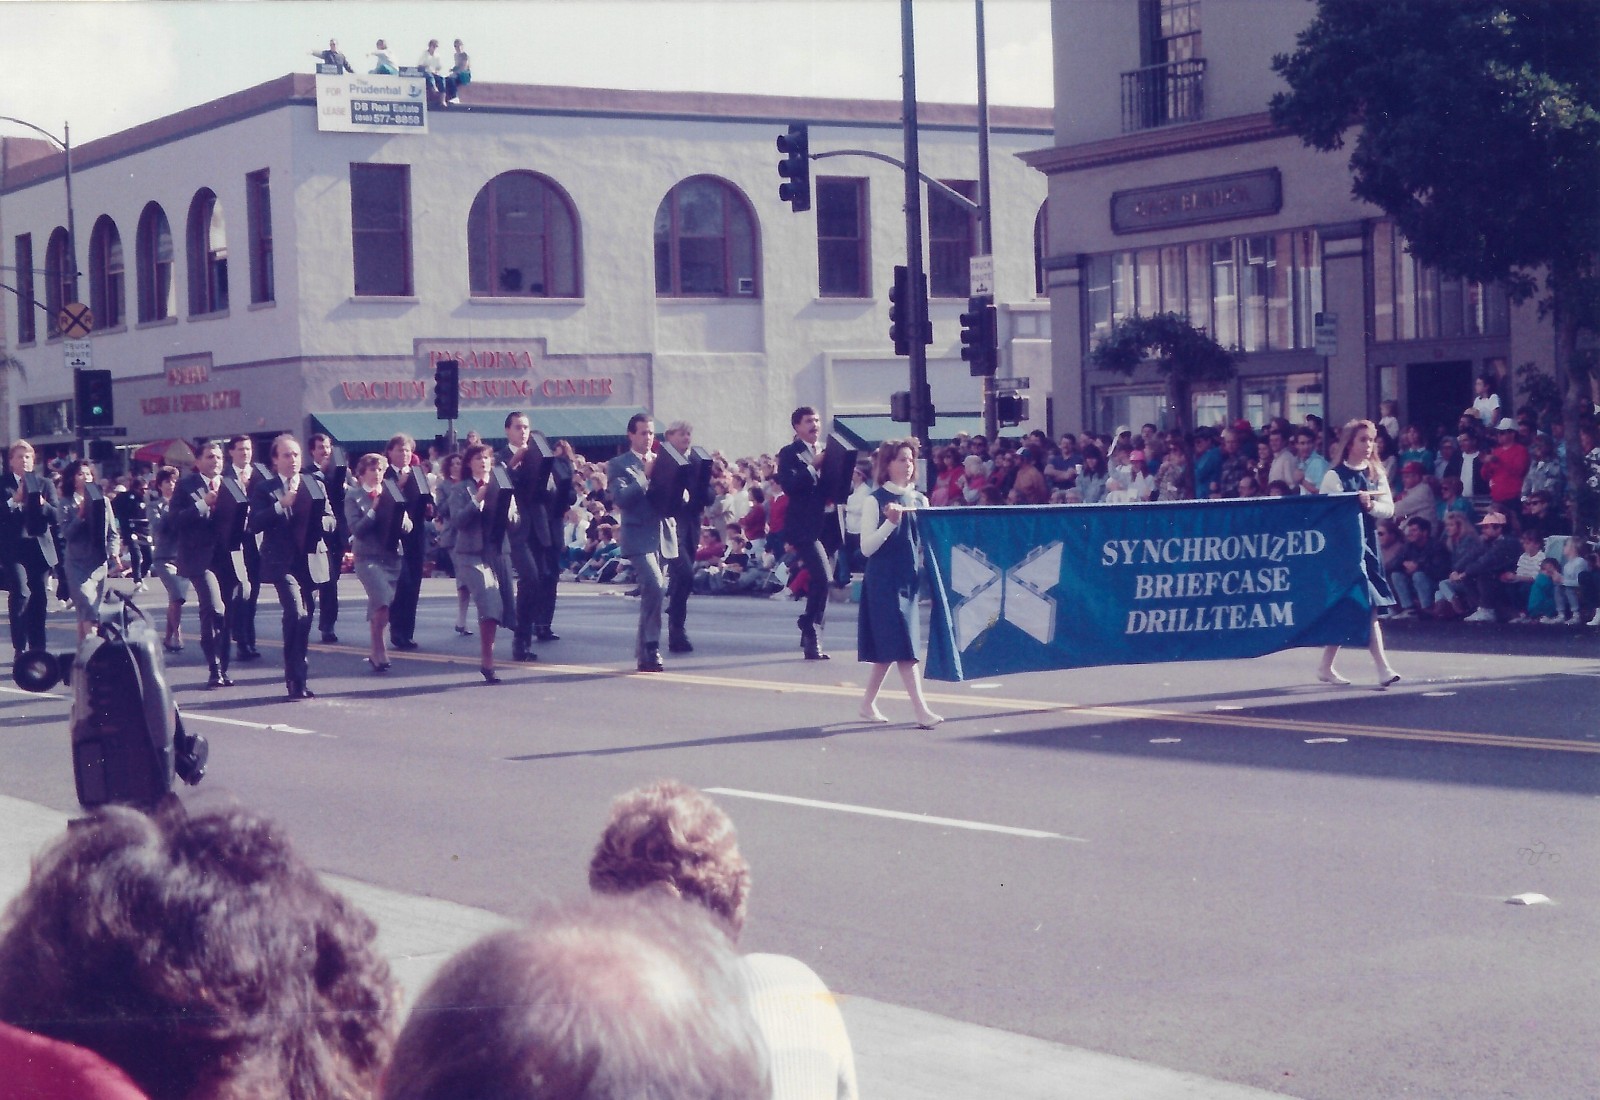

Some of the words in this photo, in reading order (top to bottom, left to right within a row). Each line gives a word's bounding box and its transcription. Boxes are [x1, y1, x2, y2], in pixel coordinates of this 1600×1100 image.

[326, 87, 342, 96] FOR
[349, 84, 401, 95] Prudential
[322, 106, 346, 116] LEASE
[354, 102, 369, 111] DB
[371, 102, 390, 112] Real
[392, 103, 420, 113] Estate
[971, 273, 992, 281] ROUTE
[342, 381, 425, 401] VACUUM
[460, 379, 533, 399] SEWING
[543, 378, 613, 399] CENTER
[1102, 529, 1326, 566] SYNCHRONIZED
[1134, 567, 1291, 600] BRIEFCASE
[1125, 602, 1295, 635] DRILLTEAM
